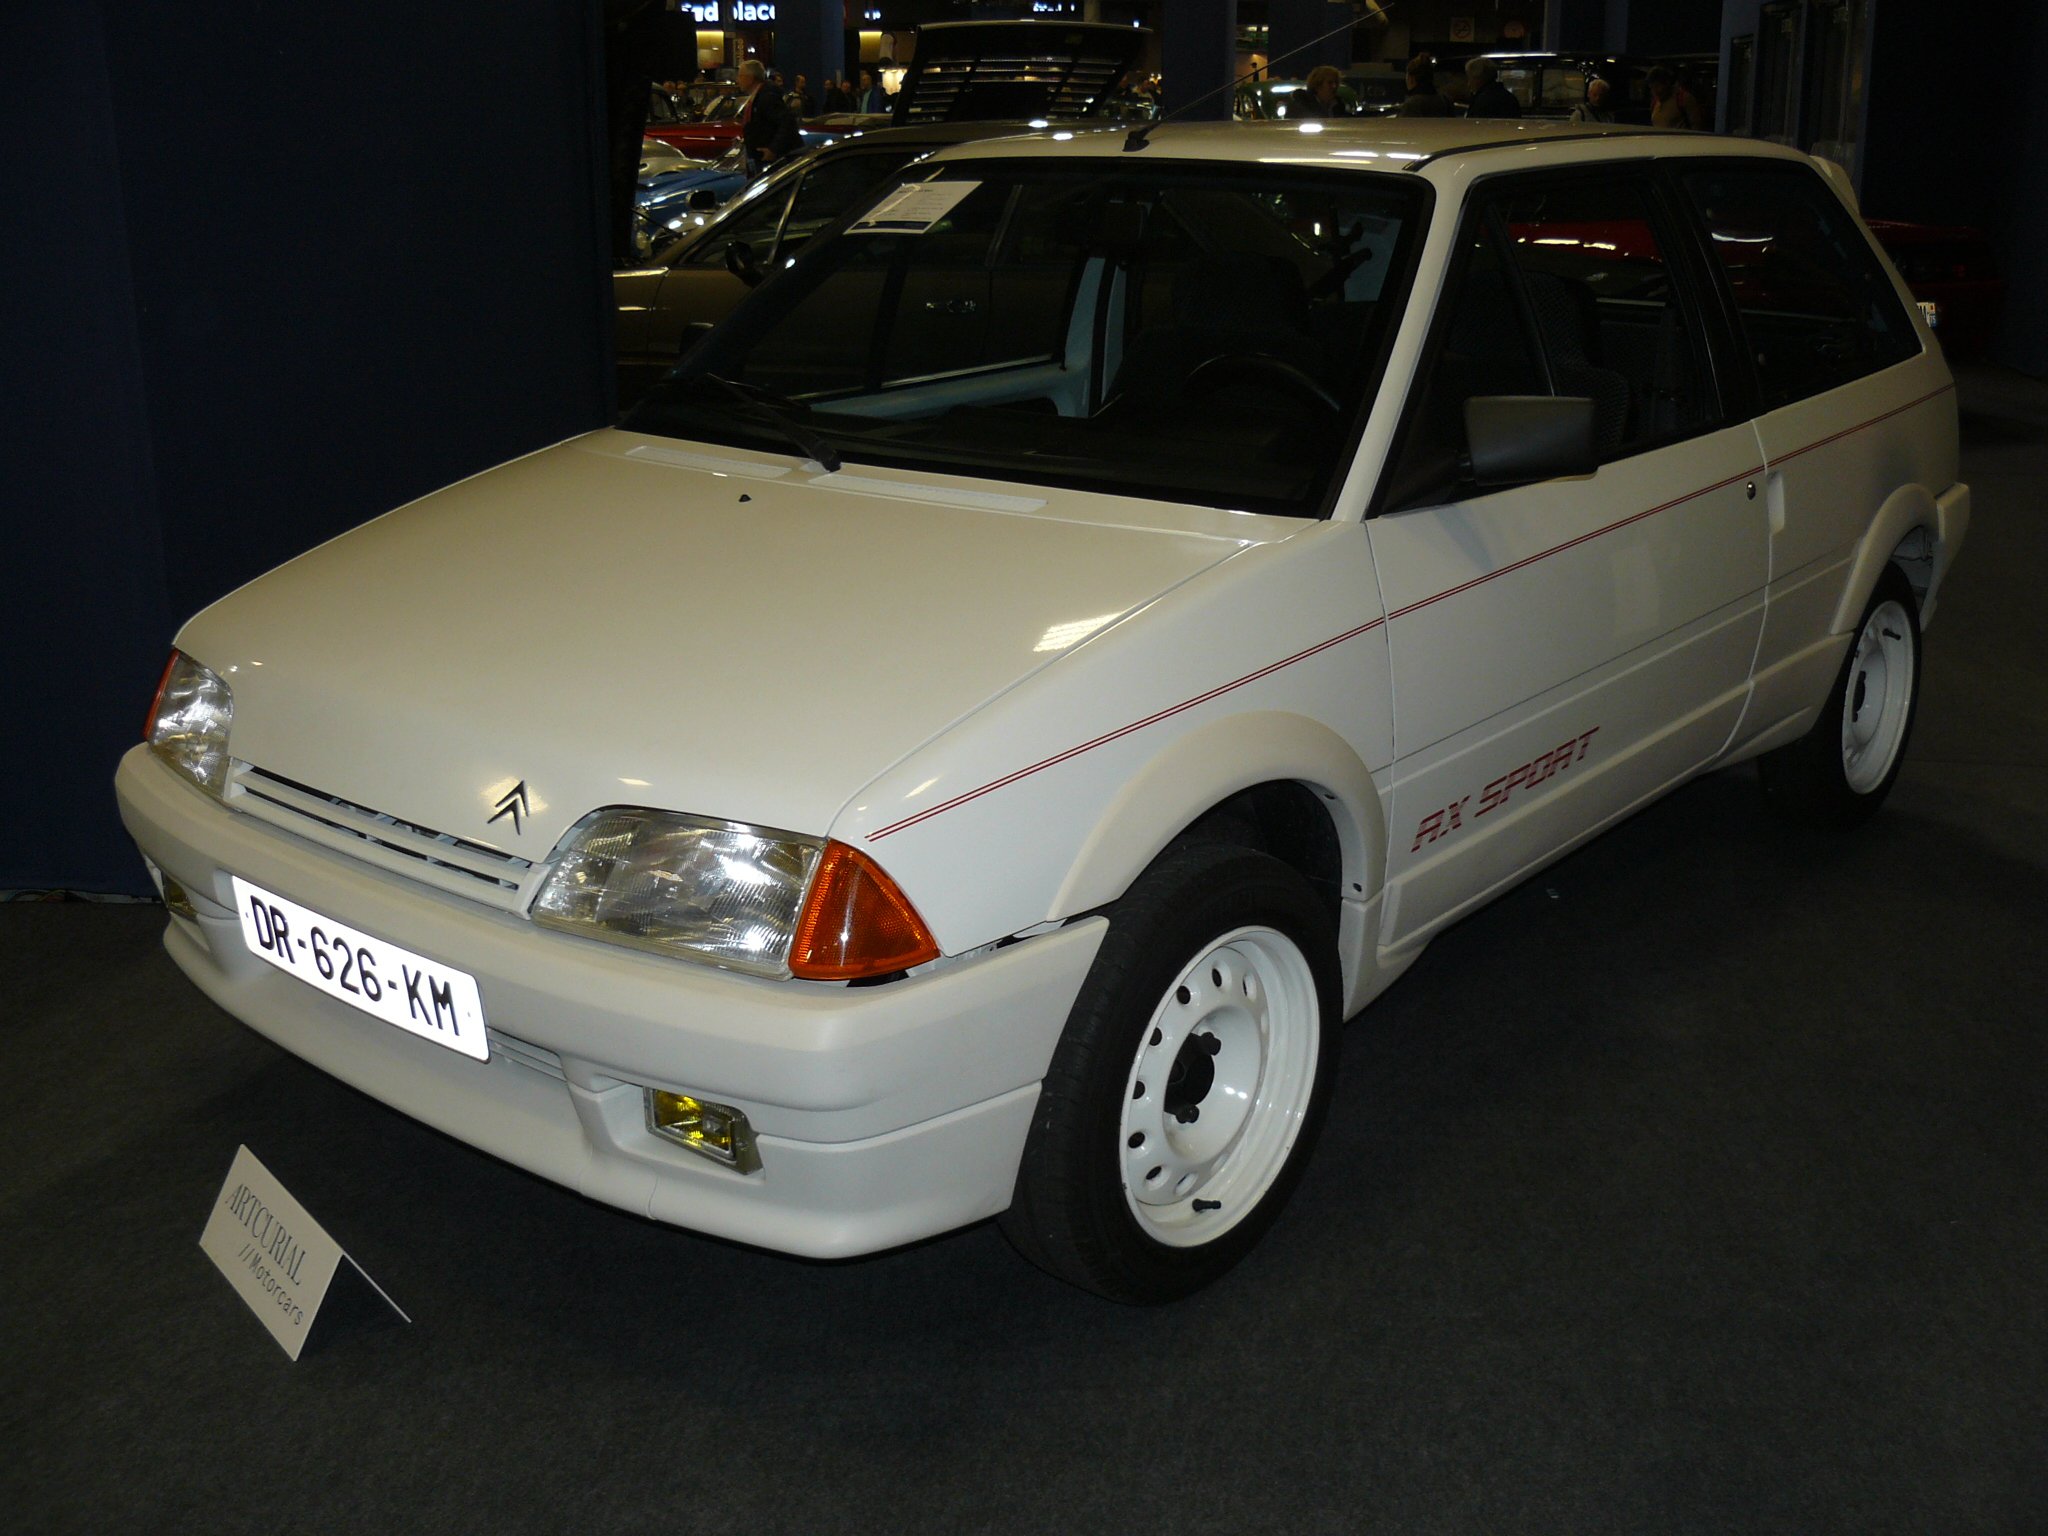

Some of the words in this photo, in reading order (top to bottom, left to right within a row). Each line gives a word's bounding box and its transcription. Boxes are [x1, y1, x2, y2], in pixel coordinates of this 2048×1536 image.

[1411, 795, 1471, 853] AX
[1474, 726, 1600, 818] SPORT
[250, 895, 460, 1036] DR-626-KM
[225, 1183, 306, 1286] ARTCURIAL
